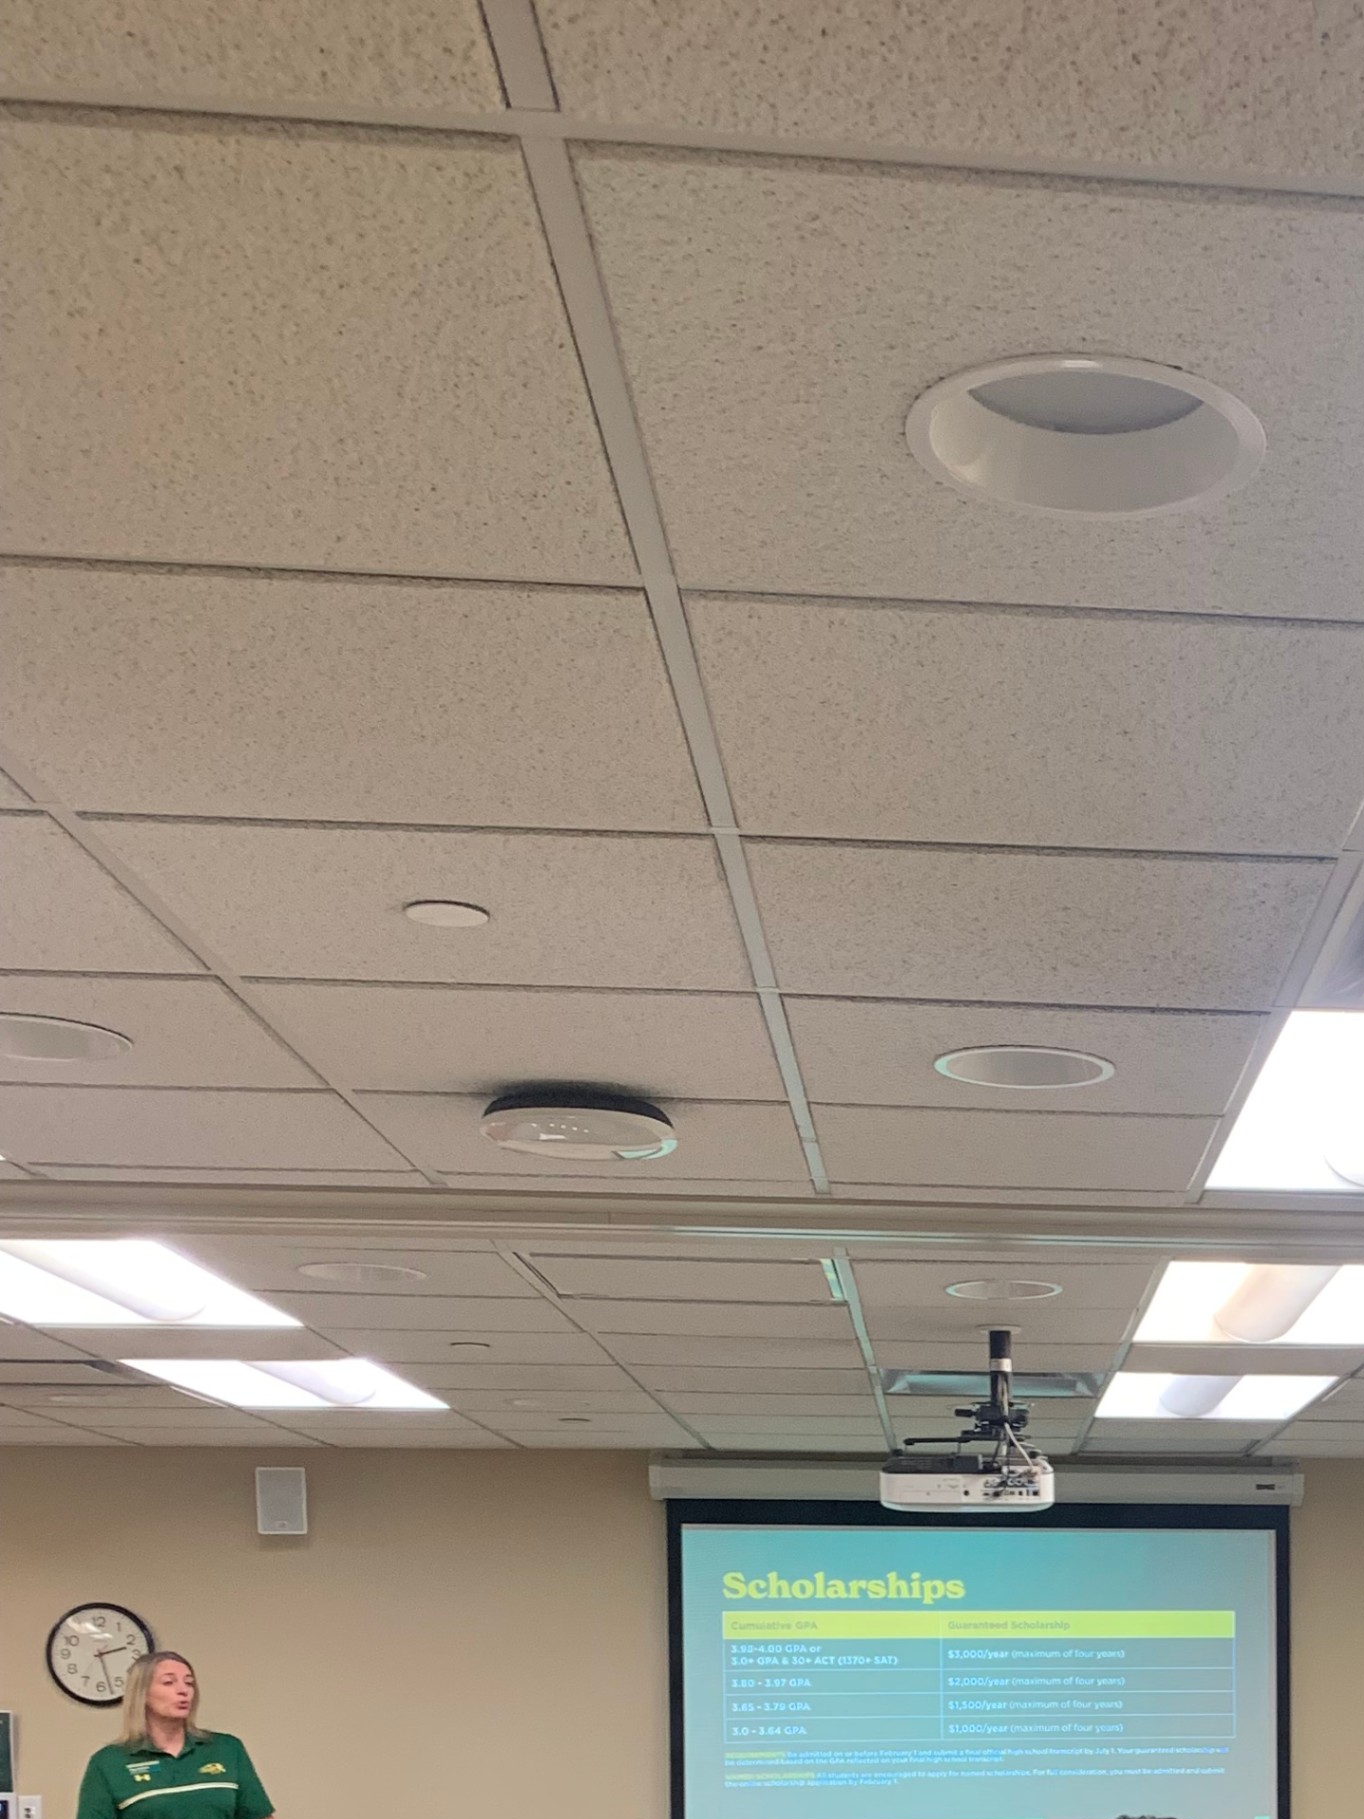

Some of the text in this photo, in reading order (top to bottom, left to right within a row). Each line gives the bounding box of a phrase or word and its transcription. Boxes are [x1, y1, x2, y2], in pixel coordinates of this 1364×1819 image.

[722, 1571, 966, 1604] Scholarships
[92, 1616, 106, 1628] 12
[116, 1622, 121, 1632] 1
[731, 1621, 819, 1631] Cumulative GPA
[947, 1621, 1071, 1631] Guaranteed Scholarship
[64, 1635, 79, 1647] 10
[126, 1634, 136, 1645] 2
[60, 1648, 71, 1660] 9
[785, 1644, 807, 1653] GPA
[757, 1656, 780, 1665] GPA
[814, 1655, 836, 1665] ACT
[873, 1655, 898, 1665] SAT)
[948, 1649, 1125, 1660] $3,000/year (maximum of four years)
[67, 1664, 78, 1675] 8
[81, 1676, 90, 1687] 7
[96, 1681, 106, 1692] 6
[114, 1676, 125, 1688] 5
[788, 1678, 813, 1688] GPA
[948, 1676, 1126, 1687] $2,000/year (maximum of four years)
[788, 1702, 812, 1711] GPA
[948, 1700, 1123, 1711] $1,500/year (maximum of four years)
[731, 1727, 750, 1736] 3.0
[784, 1725, 808, 1735] GPA
[948, 1723, 1124, 1734] $1,000/year (maximum of four years)
